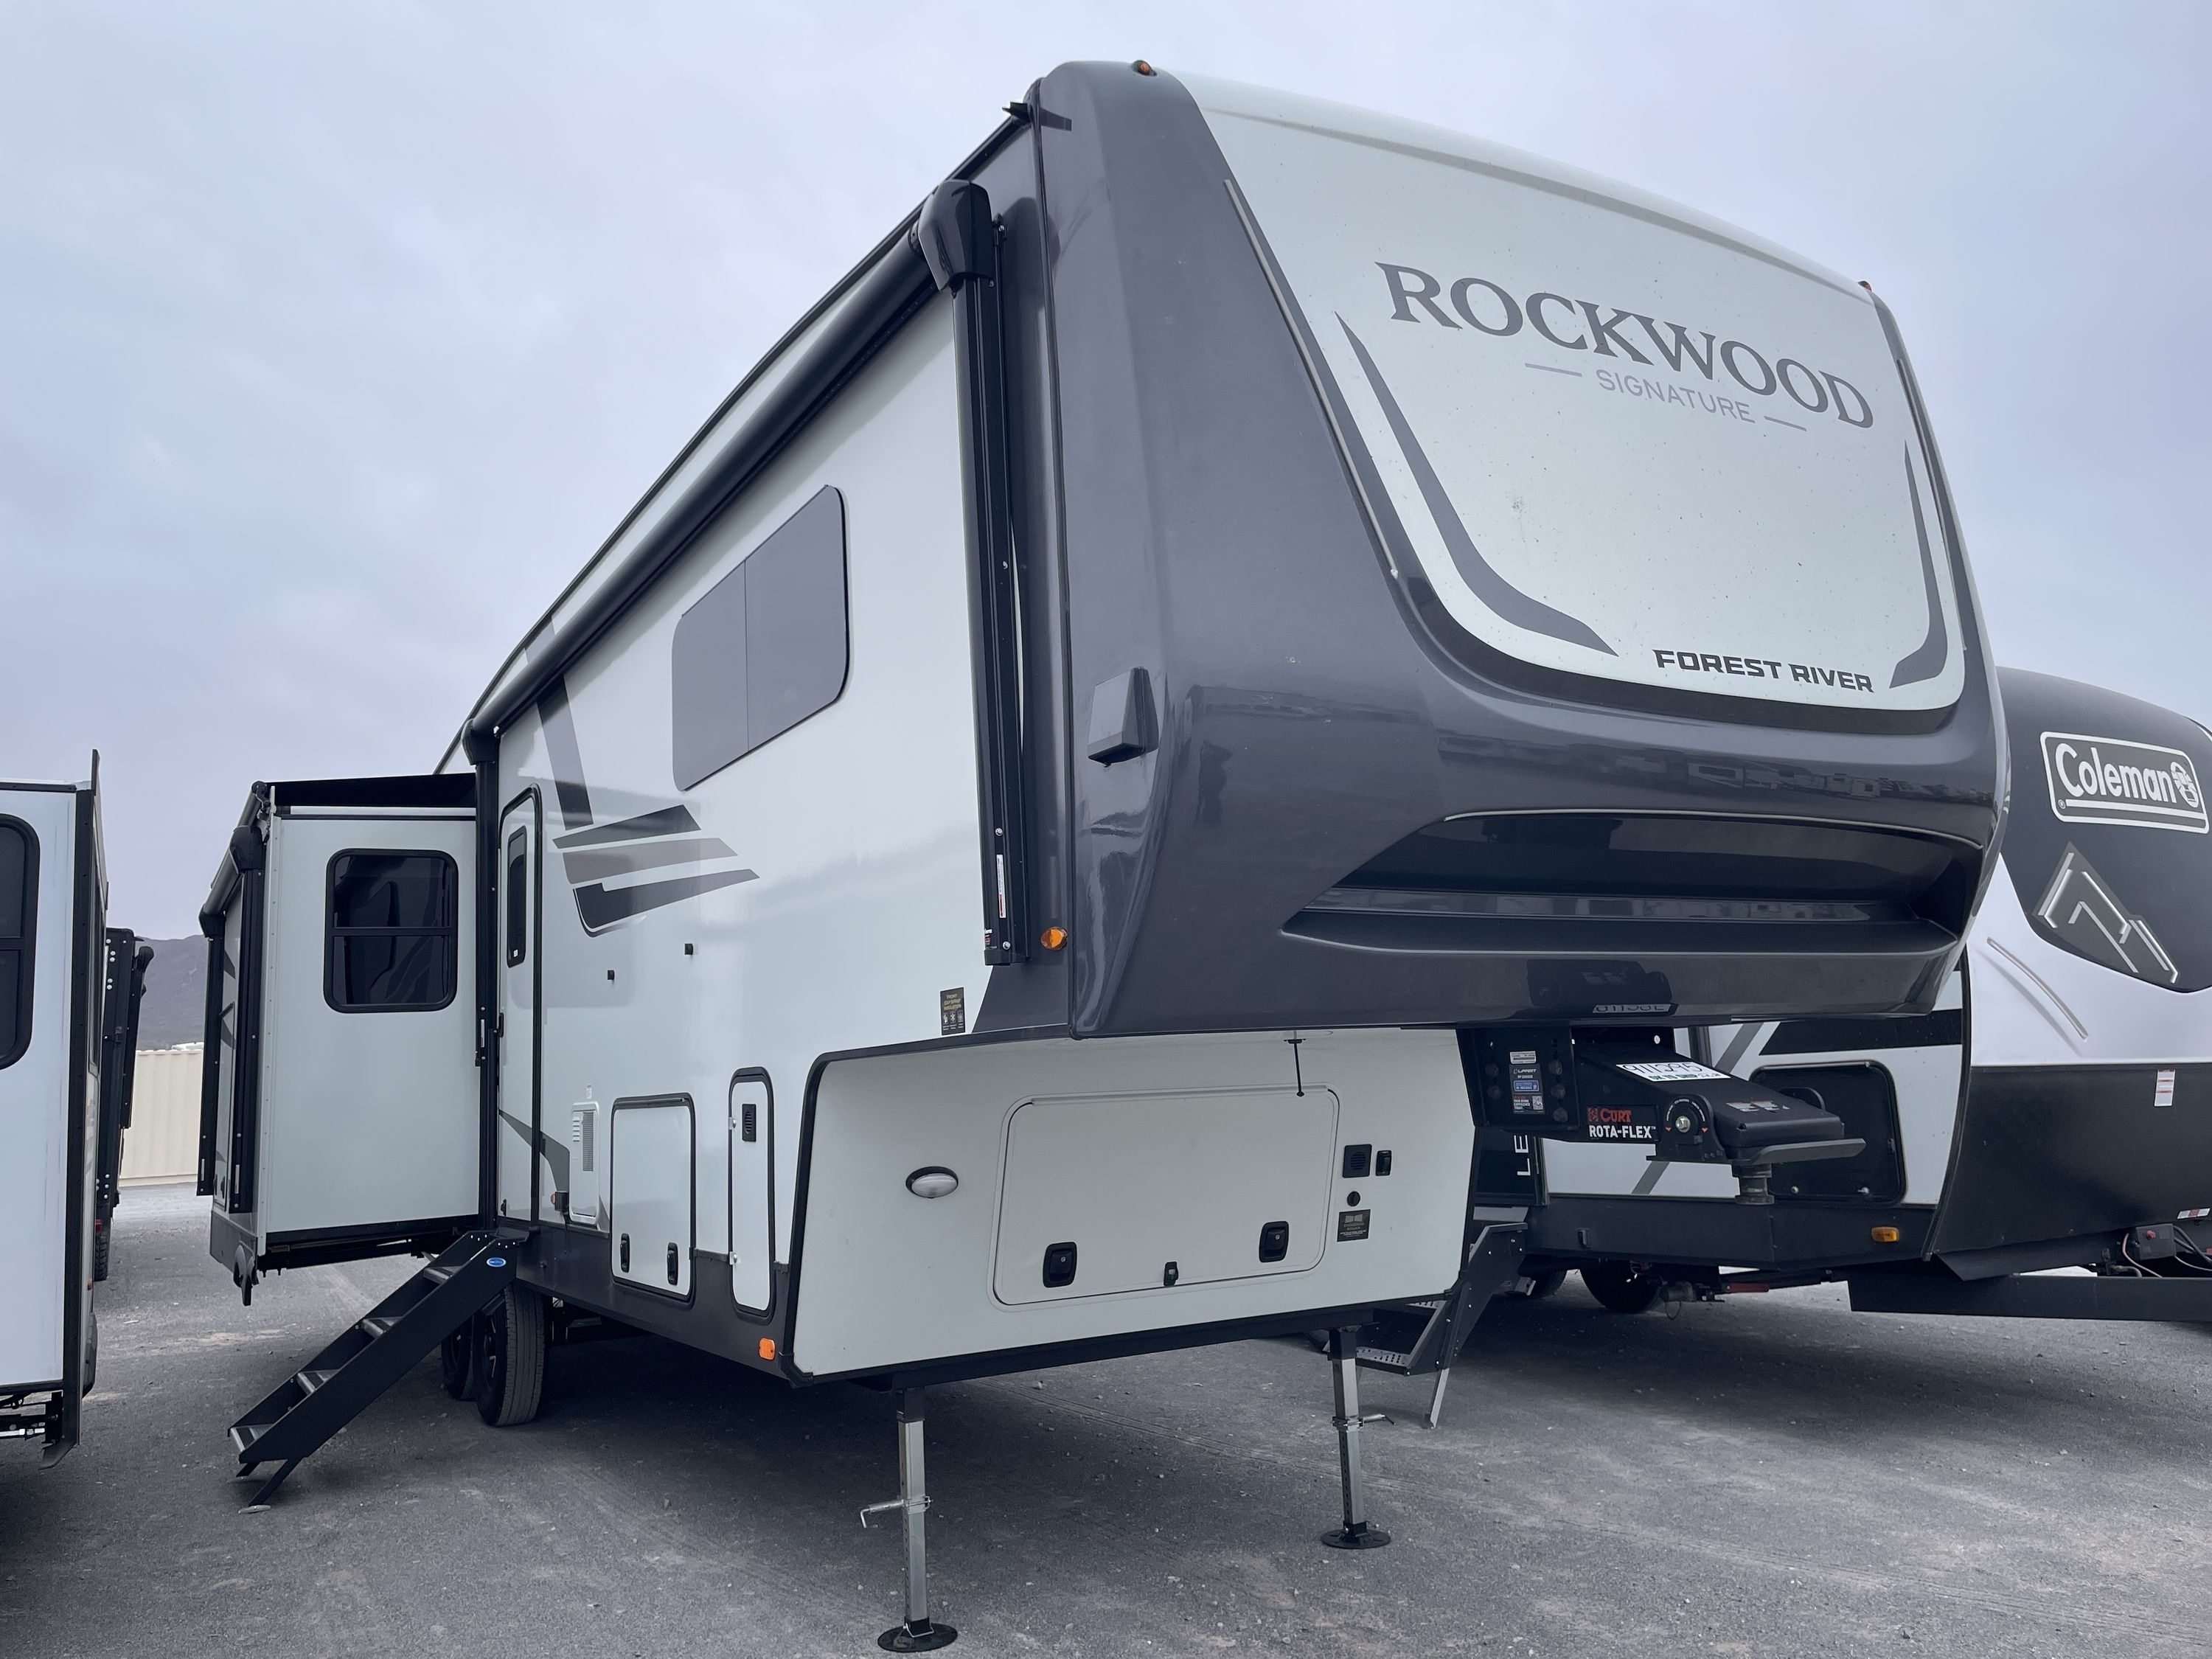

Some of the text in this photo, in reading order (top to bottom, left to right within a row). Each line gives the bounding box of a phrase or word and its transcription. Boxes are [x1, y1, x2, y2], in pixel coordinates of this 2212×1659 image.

[1374, 261, 1874, 429] ROCKWOOD
[1596, 369, 1756, 424] SIGNATURE
[1652, 649, 1874, 693] FOREST RIVER
[2055, 742, 2177, 803] Coleman
[1599, 1107, 1632, 1123] CURT
